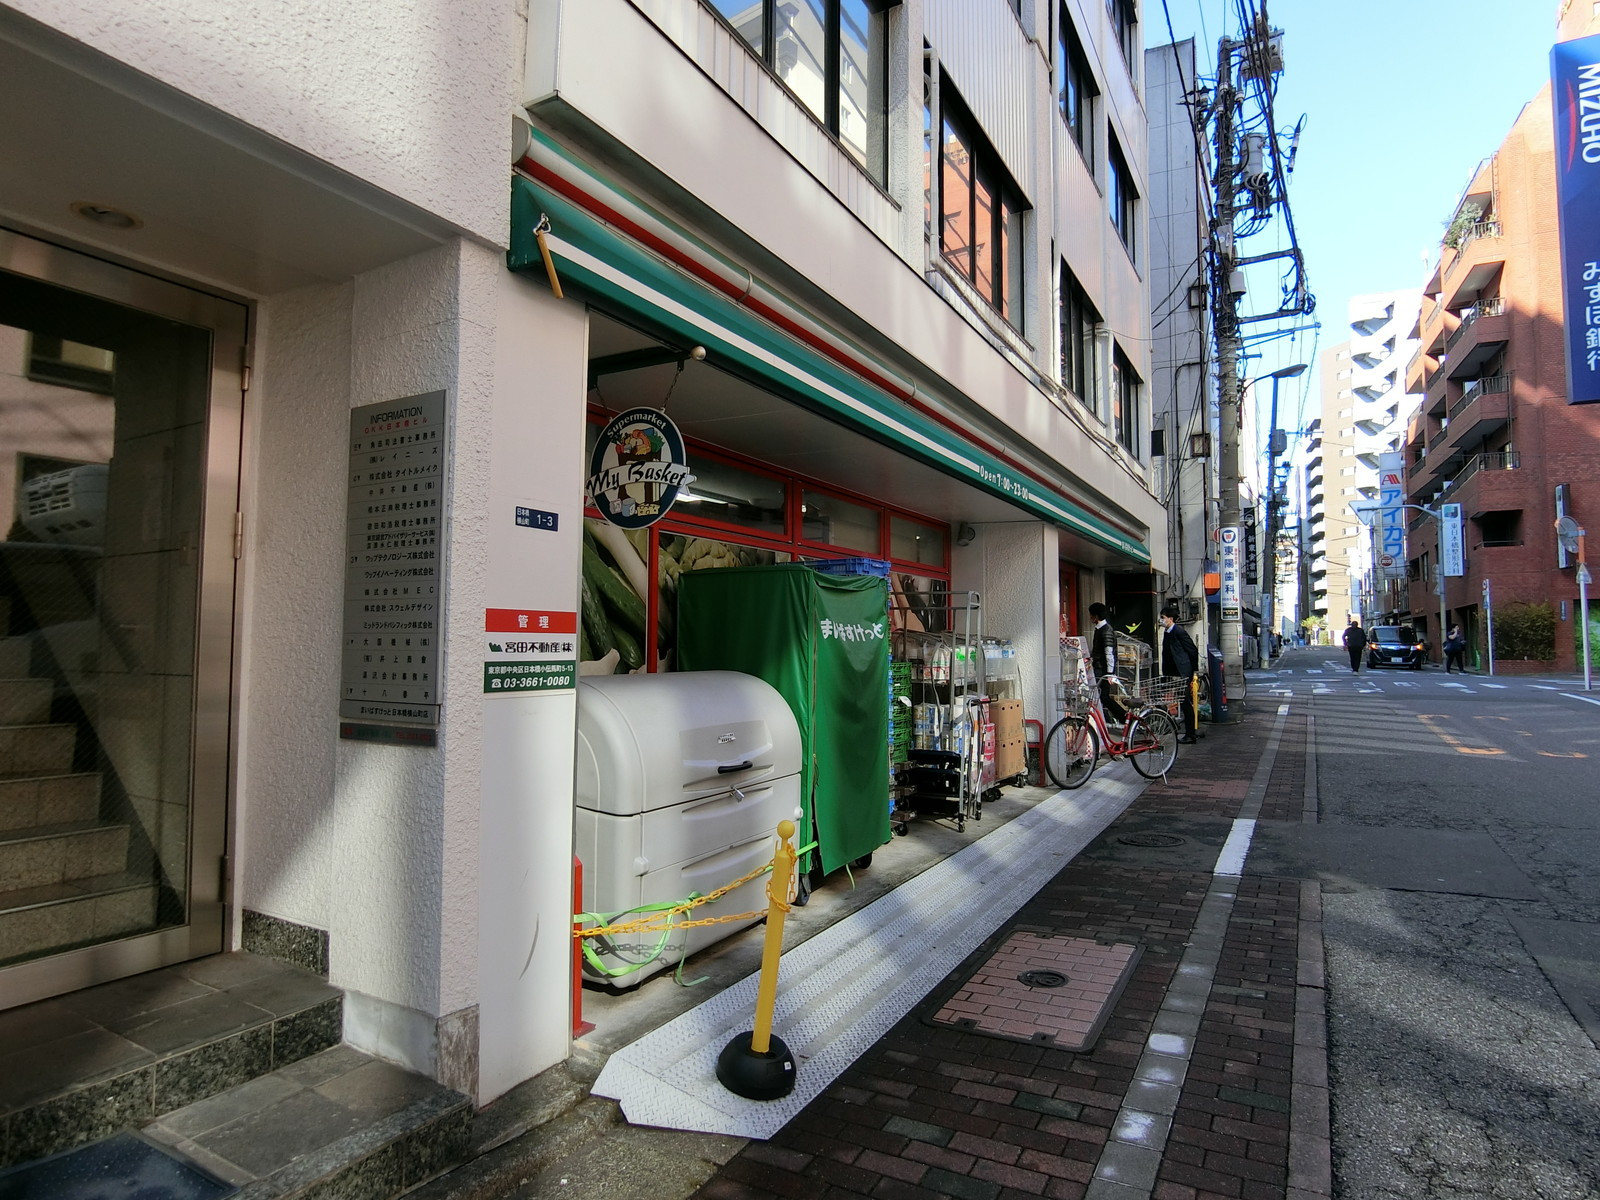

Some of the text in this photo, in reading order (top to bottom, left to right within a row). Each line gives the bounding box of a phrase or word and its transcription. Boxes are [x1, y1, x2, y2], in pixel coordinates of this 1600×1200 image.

[1577, 63, 1600, 164] MIZUHO
[370, 406, 423, 425] INFORMATION
[607, 413, 667, 439] Supermarket
[586, 460, 687, 496] My Basket
[980, 465, 996, 483] Open
[537, 514, 553, 527] 1-3
[1382, 489, 1403, 558] アイカワ
[1224, 545, 1235, 595] 東陽歯科
[518, 614, 550, 629] 管理
[820, 618, 884, 642] まいばすけっと
[503, 676, 571, 688] 03-3661-0080
